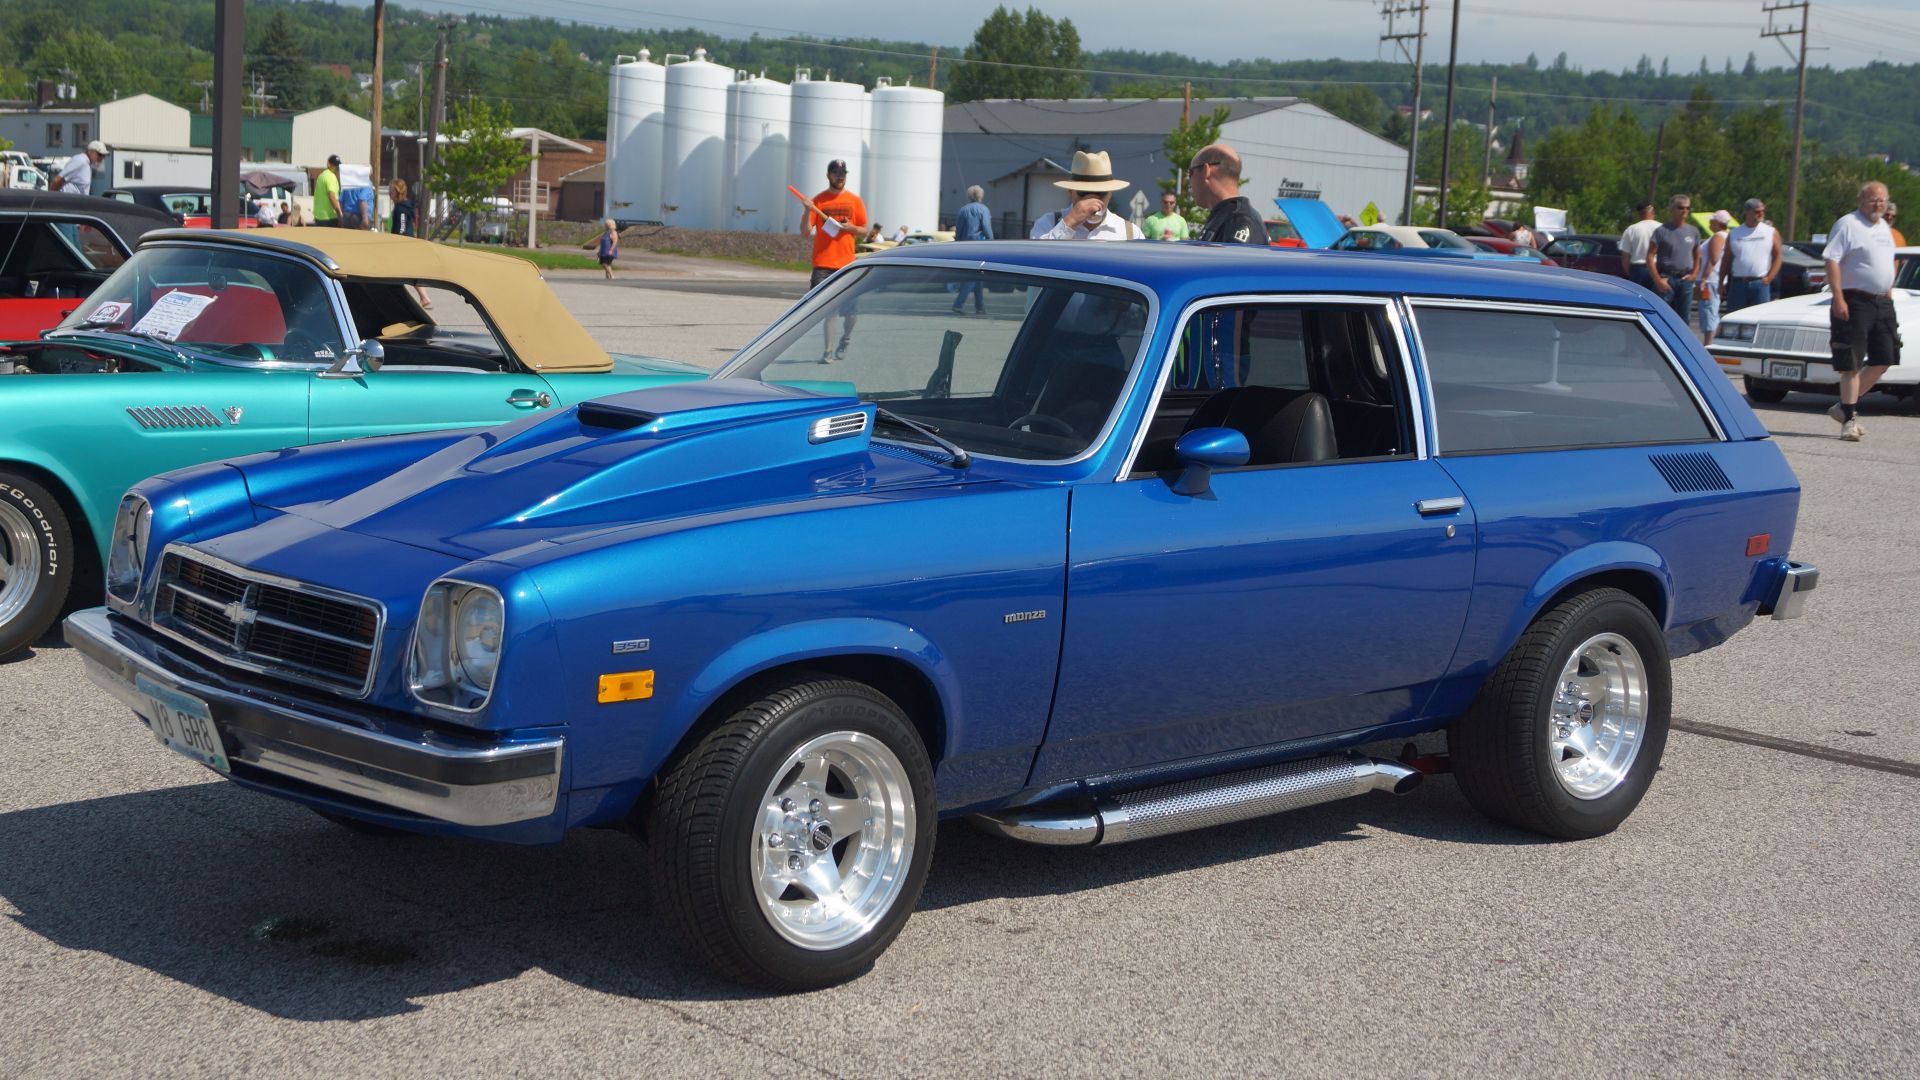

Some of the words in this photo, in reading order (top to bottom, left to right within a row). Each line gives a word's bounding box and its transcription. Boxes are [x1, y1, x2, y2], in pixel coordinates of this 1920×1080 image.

[1004, 610, 1046, 623] monza
[614, 640, 649, 652] 350
[177, 711, 215, 753] GR8
